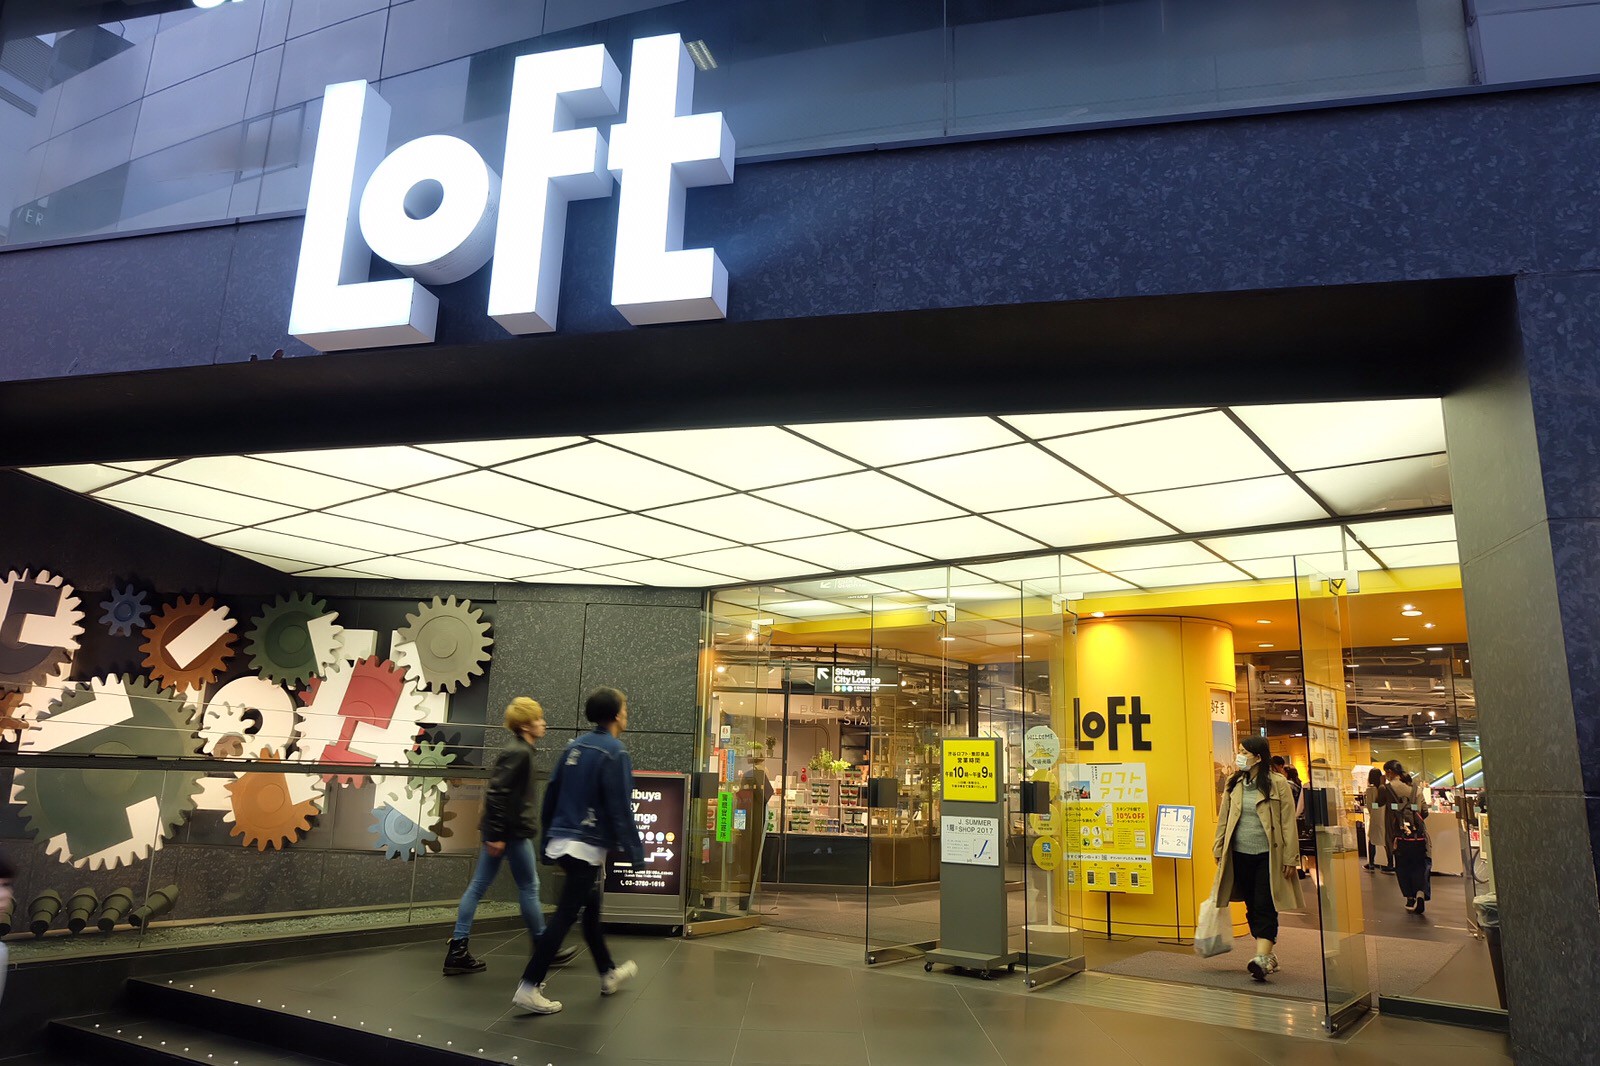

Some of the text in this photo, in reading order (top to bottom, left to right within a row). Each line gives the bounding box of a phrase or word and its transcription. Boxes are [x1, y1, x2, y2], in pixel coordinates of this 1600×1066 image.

[835, 668, 866, 677] Shibuya
[835, 676, 881, 686] City Lounge
[843, 714, 886, 726] STAGE
[1100, 771, 1141, 784] ロフト
[631, 788, 662, 802] ibuya
[965, 819, 992, 827] SUMMER
